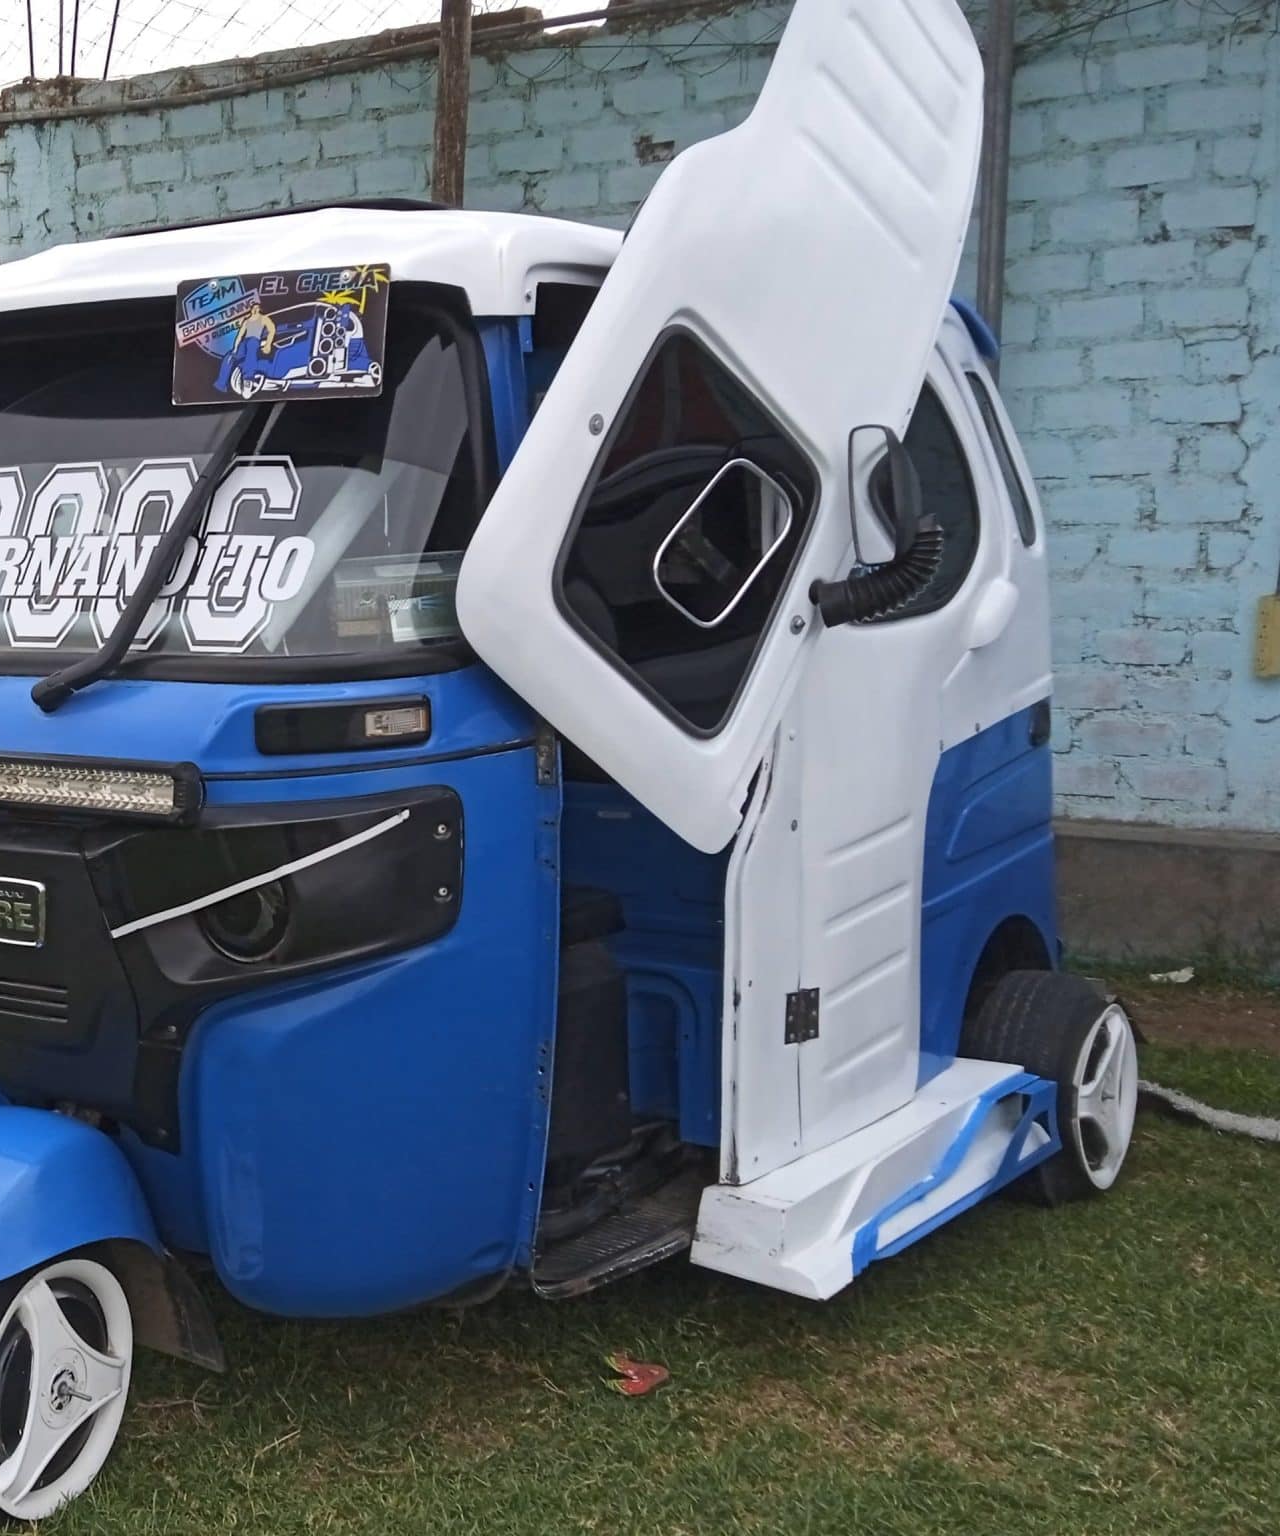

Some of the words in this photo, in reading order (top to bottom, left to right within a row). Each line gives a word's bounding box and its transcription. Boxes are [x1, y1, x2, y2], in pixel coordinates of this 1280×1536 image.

[189, 281, 236, 312] TEAM
[259, 276, 288, 296] EL
[182, 315, 215, 337] BRAVO
[218, 297, 256, 320] TUNING
